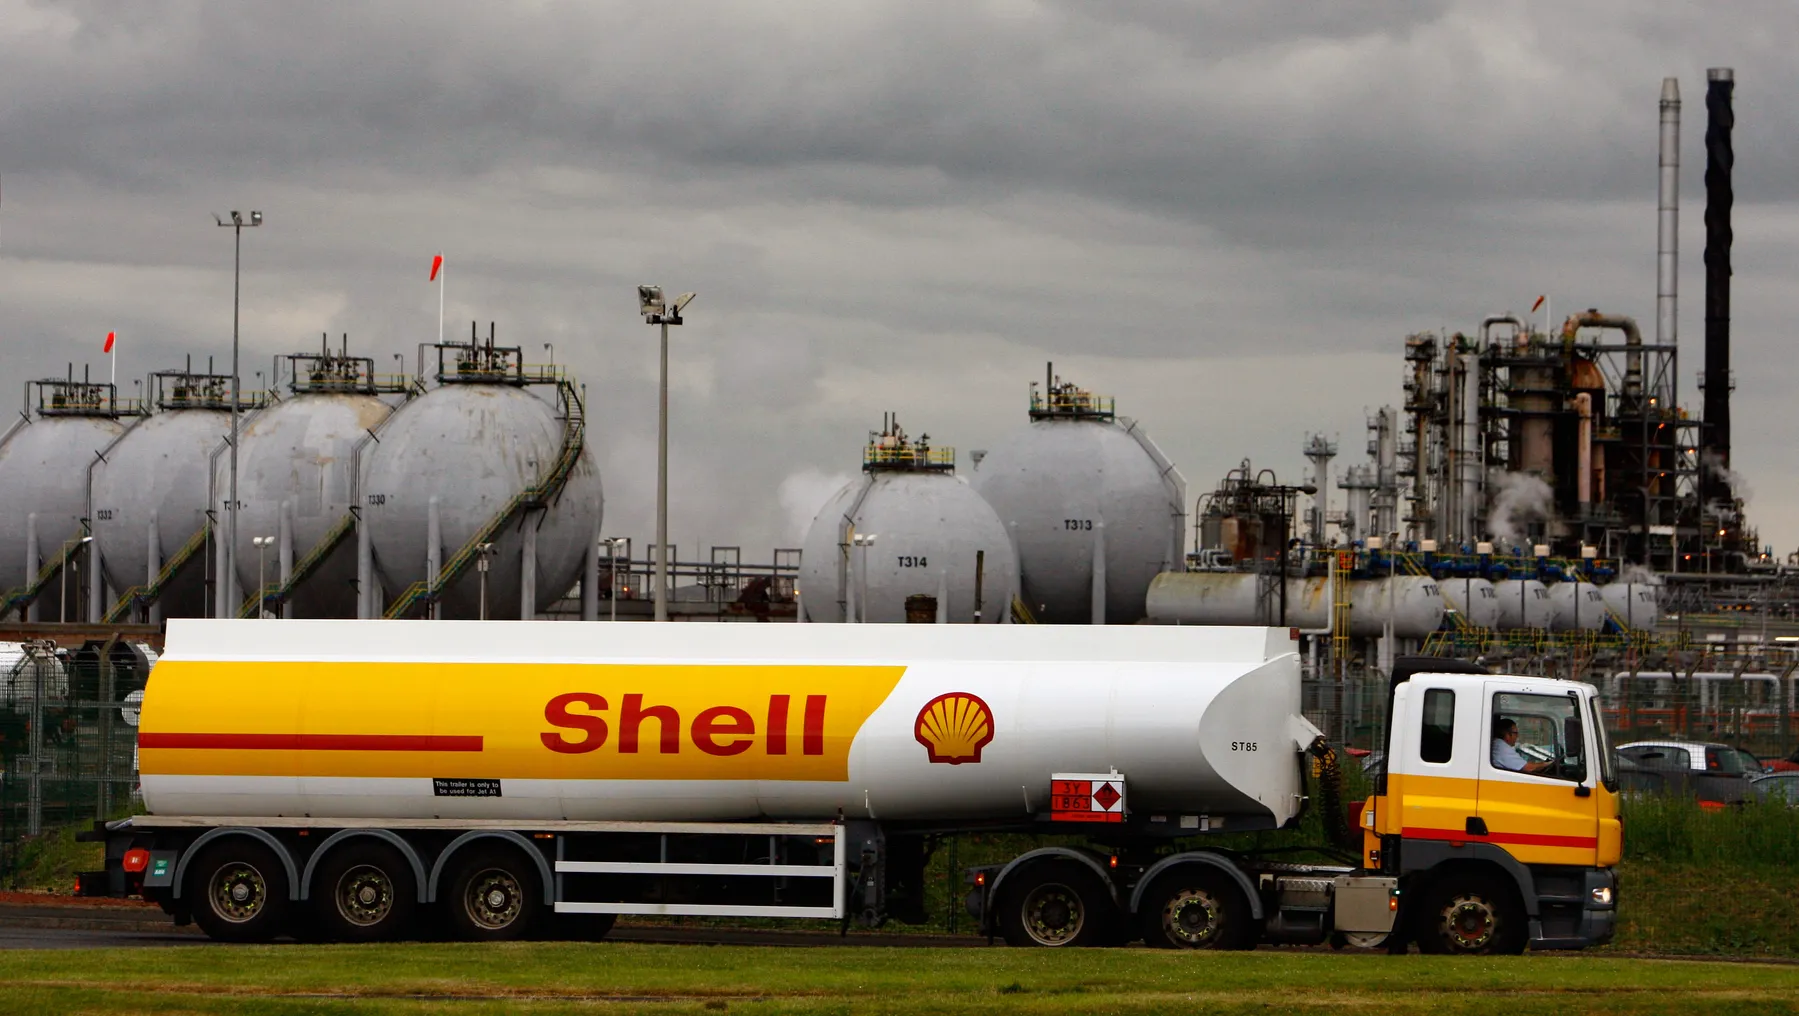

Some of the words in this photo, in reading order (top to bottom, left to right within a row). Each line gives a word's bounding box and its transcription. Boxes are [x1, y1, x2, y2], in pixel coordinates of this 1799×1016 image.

[1064, 519, 1092, 531] T313
[897, 556, 927, 568] T314
[540, 692, 827, 756] Shell
[1231, 741, 1258, 753] ST85
[477, 781, 490, 789] only
[1063, 782, 1080, 794] 3Y
[1055, 797, 1090, 809] 1863
